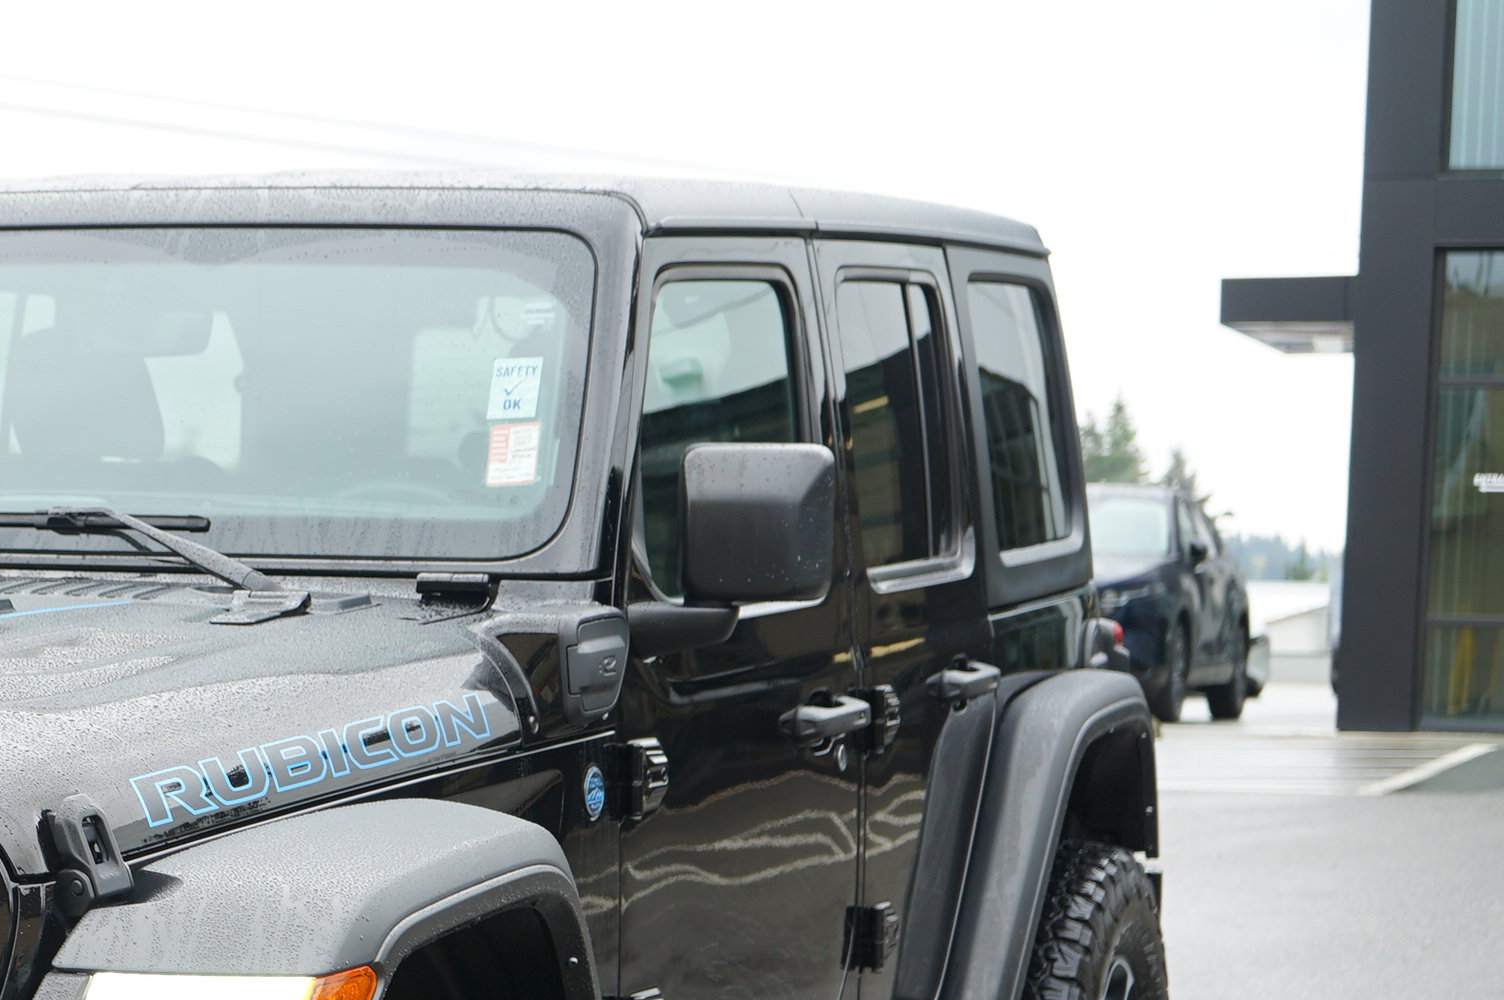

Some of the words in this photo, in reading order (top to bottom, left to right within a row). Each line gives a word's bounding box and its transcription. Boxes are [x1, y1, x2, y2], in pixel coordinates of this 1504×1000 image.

[496, 366, 538, 377] SAFETY
[503, 400, 521, 410] OK
[130, 693, 491, 828] RUBICON
